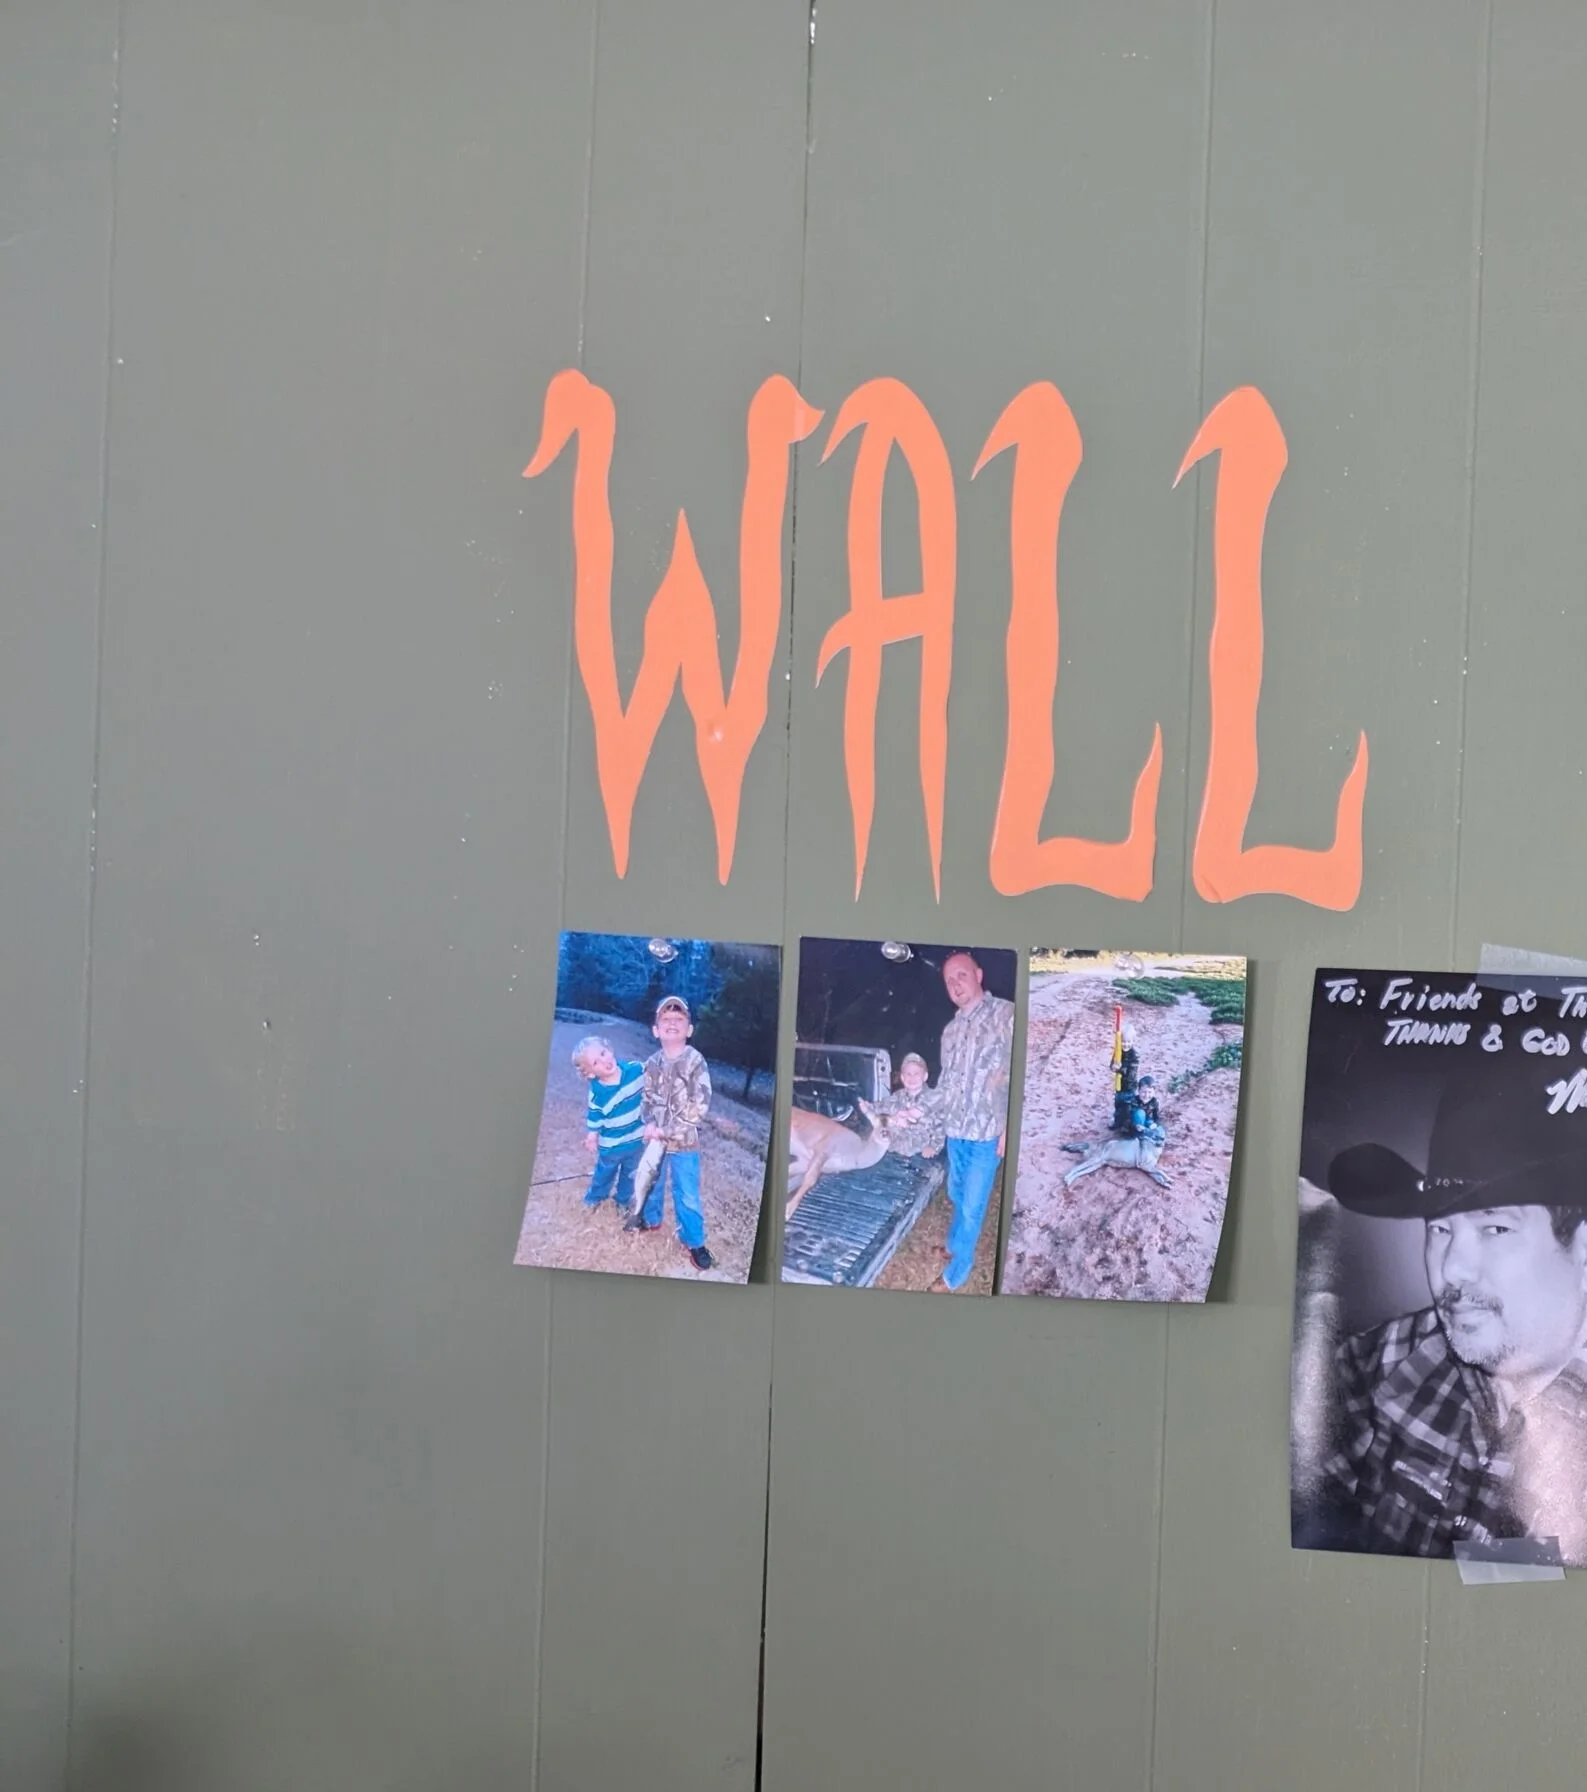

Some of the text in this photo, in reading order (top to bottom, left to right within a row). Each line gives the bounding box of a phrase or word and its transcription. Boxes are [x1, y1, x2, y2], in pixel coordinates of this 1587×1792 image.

[525, 369, 1368, 910] WALL
[1379, 977, 1482, 1012] Friends
[1502, 989, 1537, 1016] at
[1481, 1024, 1504, 1053] &
[1522, 1028, 1571, 1056] GOD
